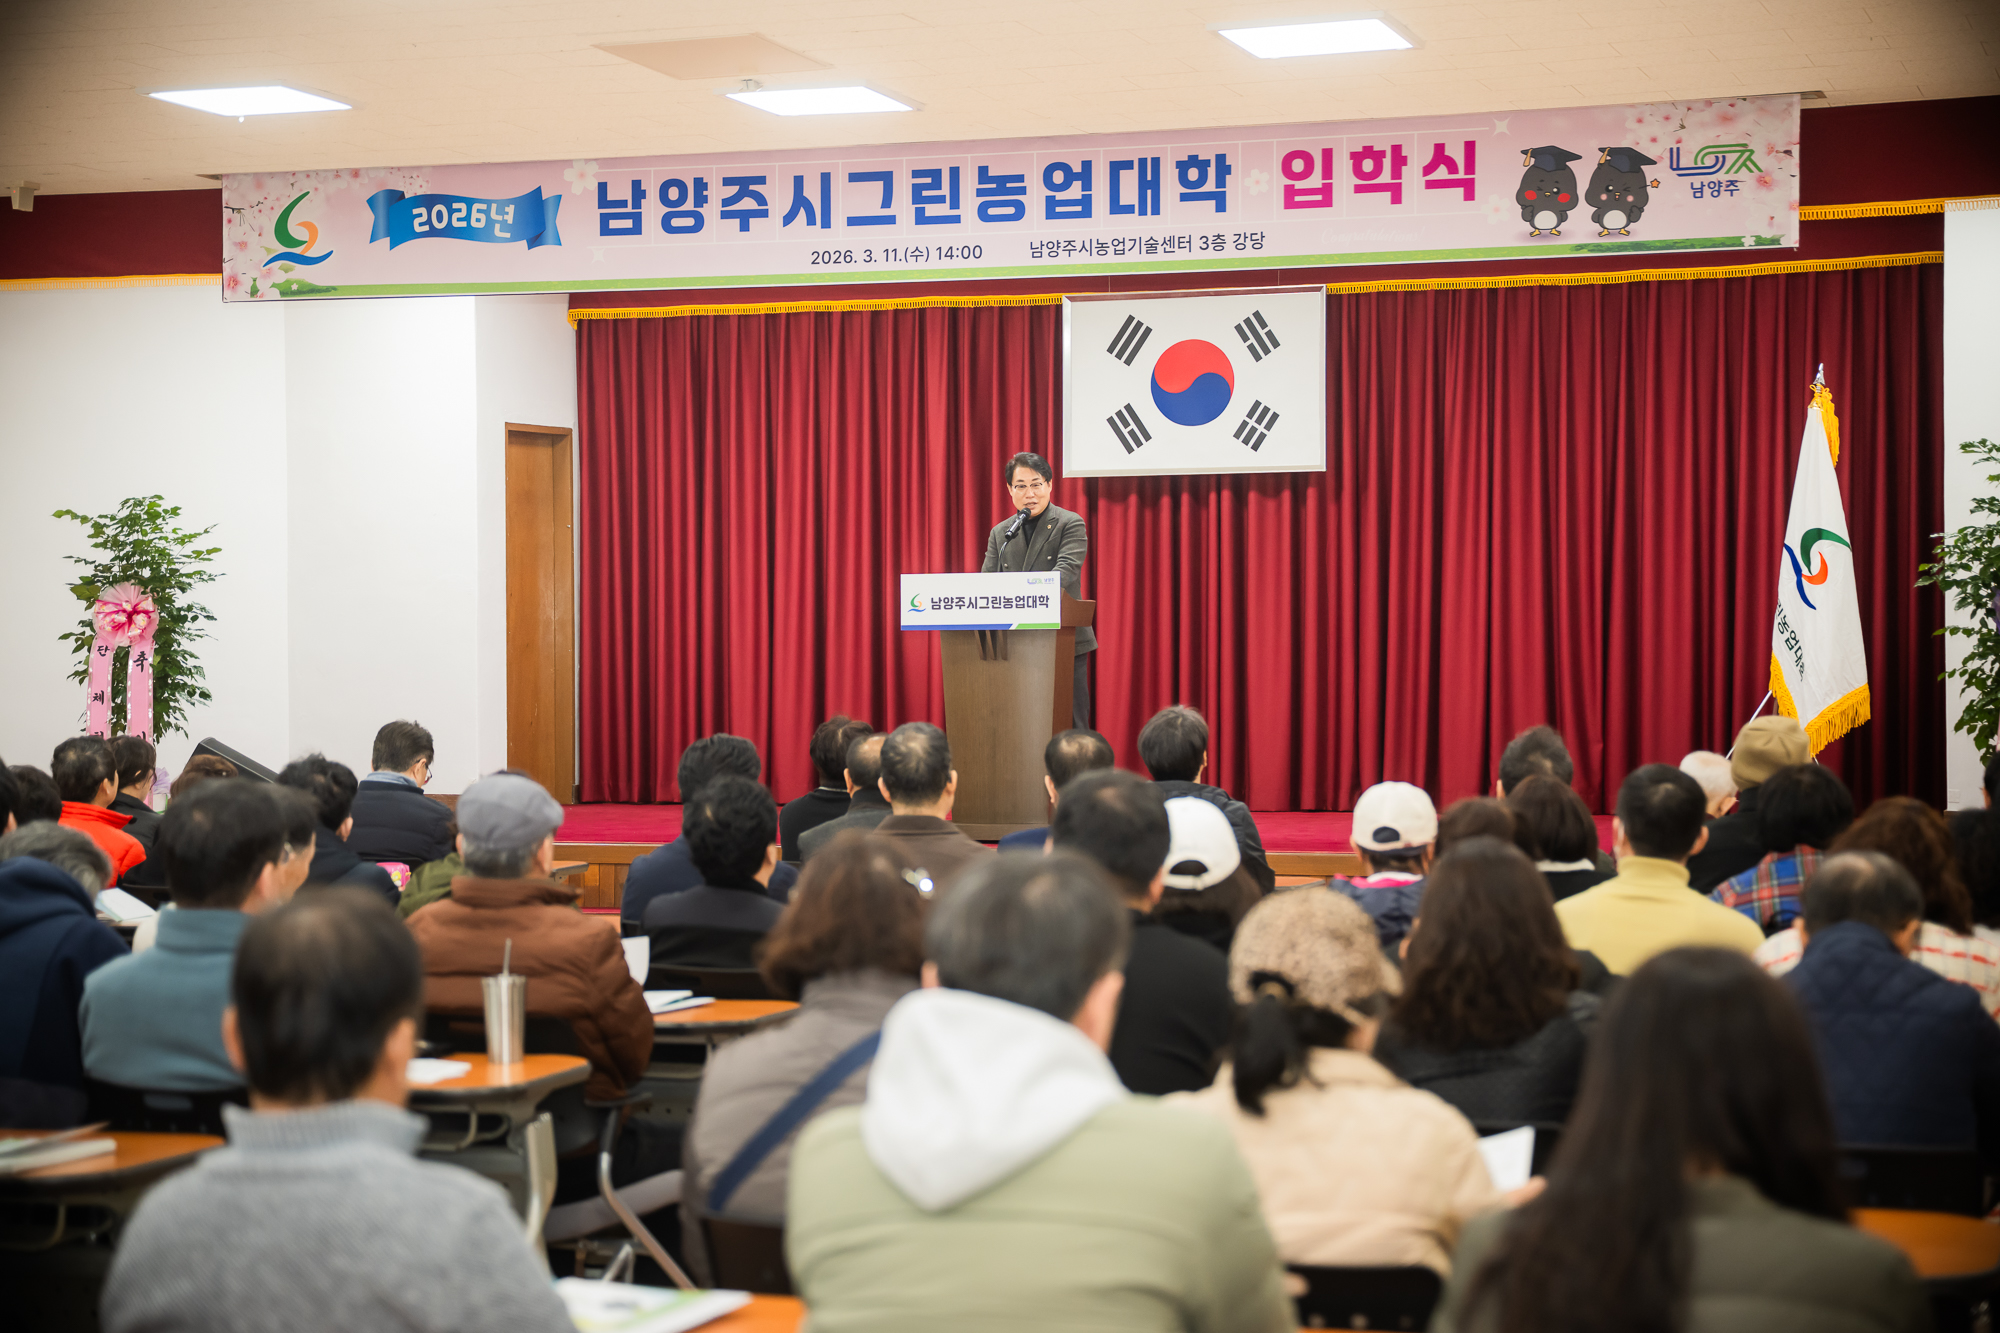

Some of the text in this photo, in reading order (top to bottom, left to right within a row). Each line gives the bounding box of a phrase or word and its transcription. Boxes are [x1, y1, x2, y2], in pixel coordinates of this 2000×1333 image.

[598, 140, 1476, 236] 남양주시그린농업대학 입학식
[1691, 180, 1740, 198] 남양주
[413, 205, 515, 239] 2026년
[811, 244, 983, 266] 2026. 3. 11.(수) 14:00
[1030, 231, 1266, 260] 남양주시농업기술센터 3층 강당
[931, 595, 1048, 610] 남양주시그린농업대학
